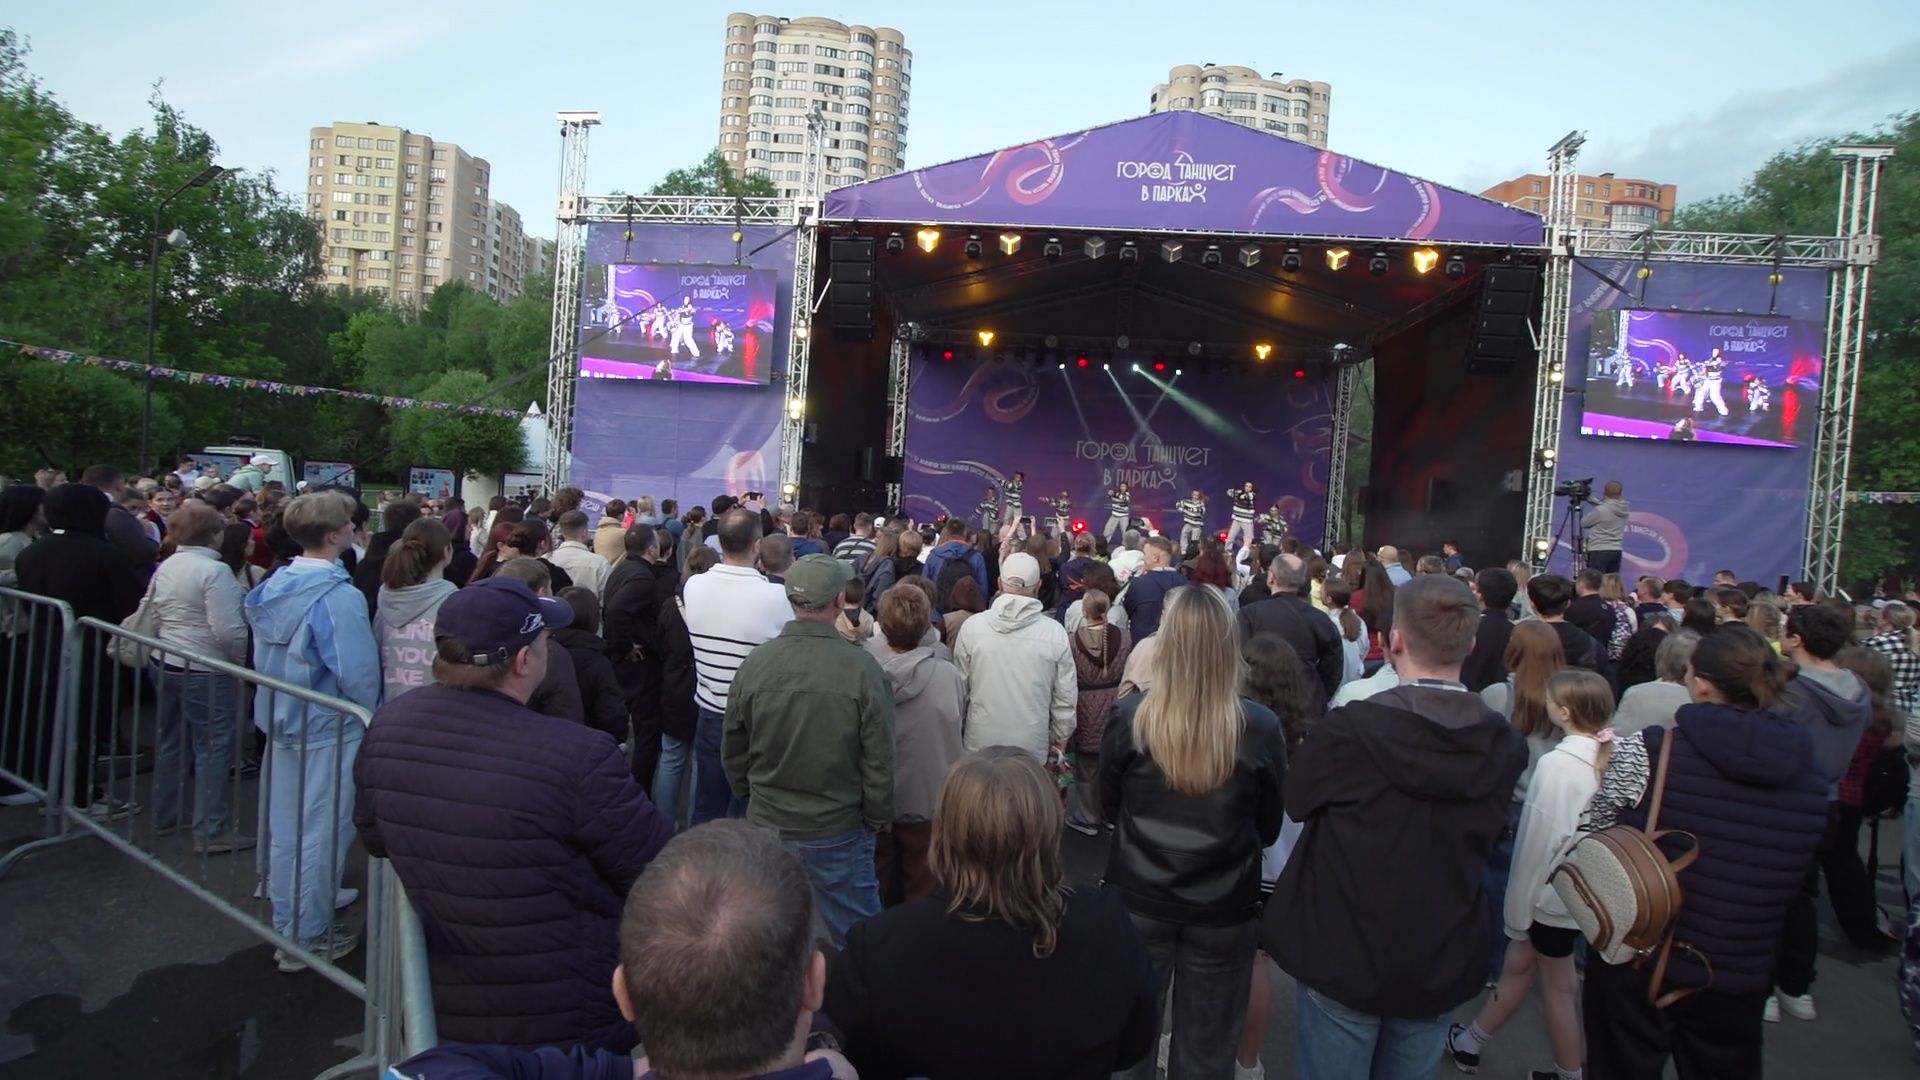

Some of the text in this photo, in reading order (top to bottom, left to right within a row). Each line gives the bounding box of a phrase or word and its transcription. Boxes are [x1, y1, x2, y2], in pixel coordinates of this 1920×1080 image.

[1117, 161, 1172, 181] ГОРОД
[1141, 183, 1207, 203] В ПАРКАХ
[1076, 440, 1138, 463] ГОРОД
[1104, 468, 1177, 490] В ПАРКАХ
[395, 647, 438, 665] YOU
